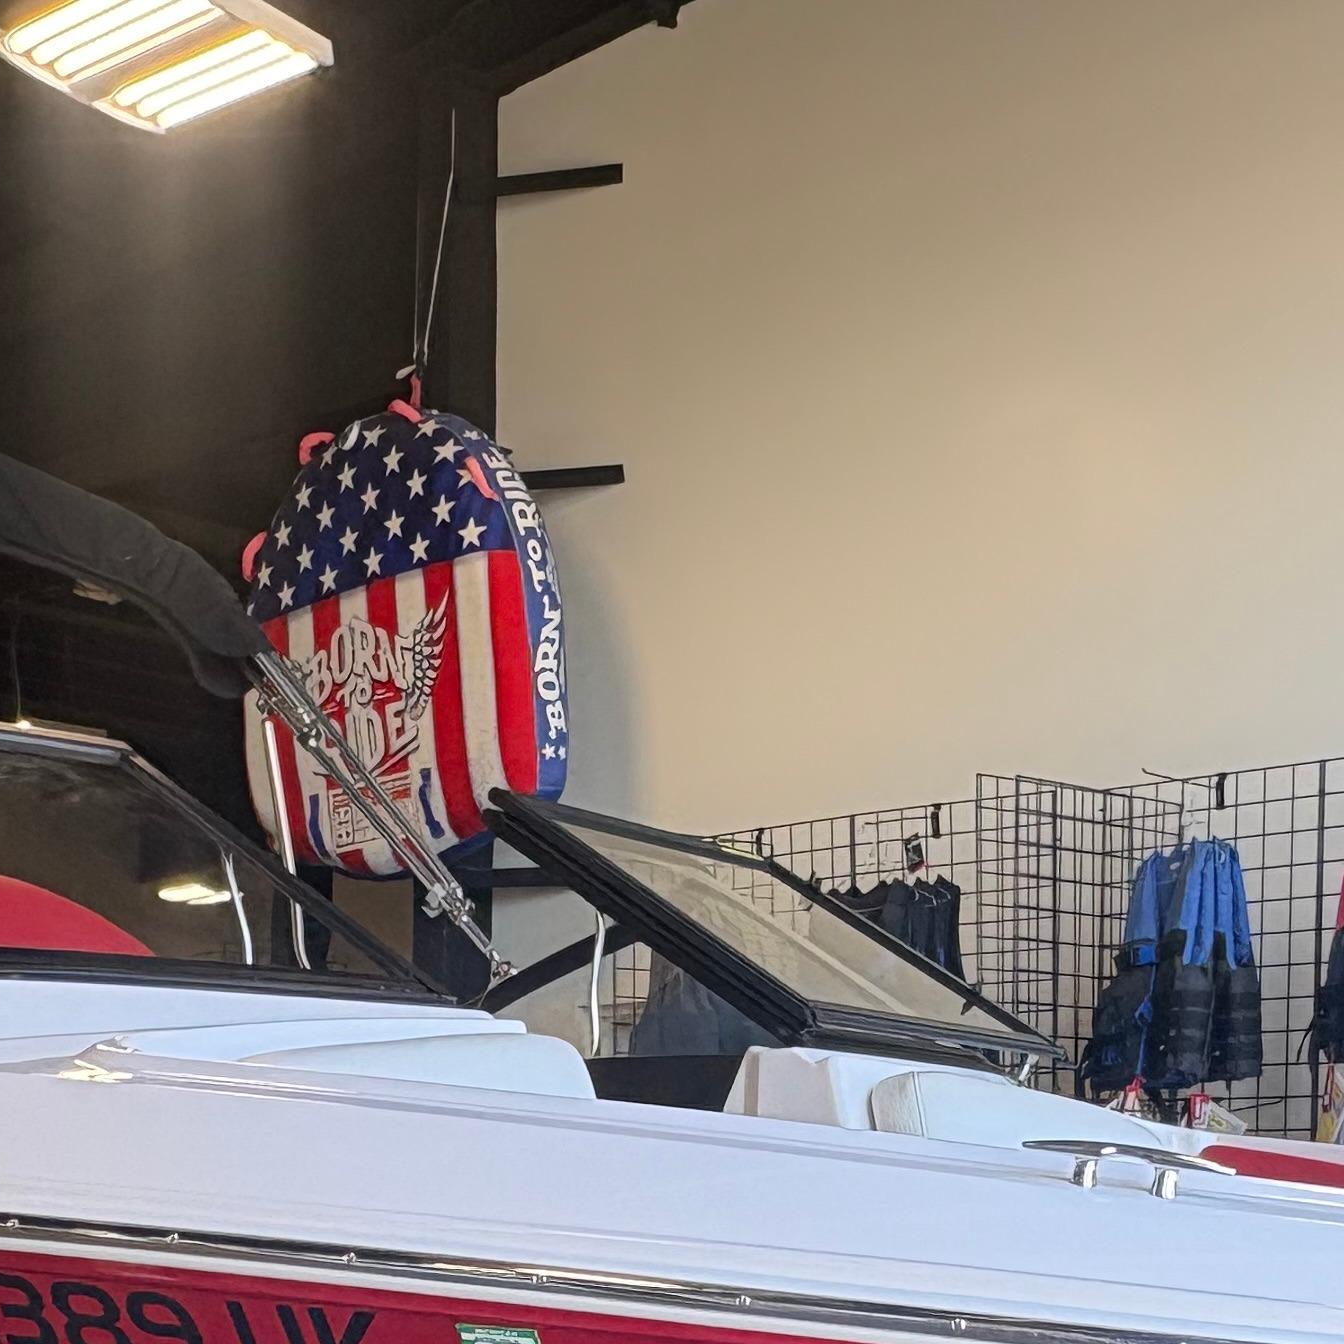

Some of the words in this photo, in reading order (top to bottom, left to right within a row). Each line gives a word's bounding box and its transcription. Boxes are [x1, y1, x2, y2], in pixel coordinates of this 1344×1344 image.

[526, 537, 547, 593] TO
[305, 617, 416, 707] BORN
[534, 594, 567, 740] BORN
